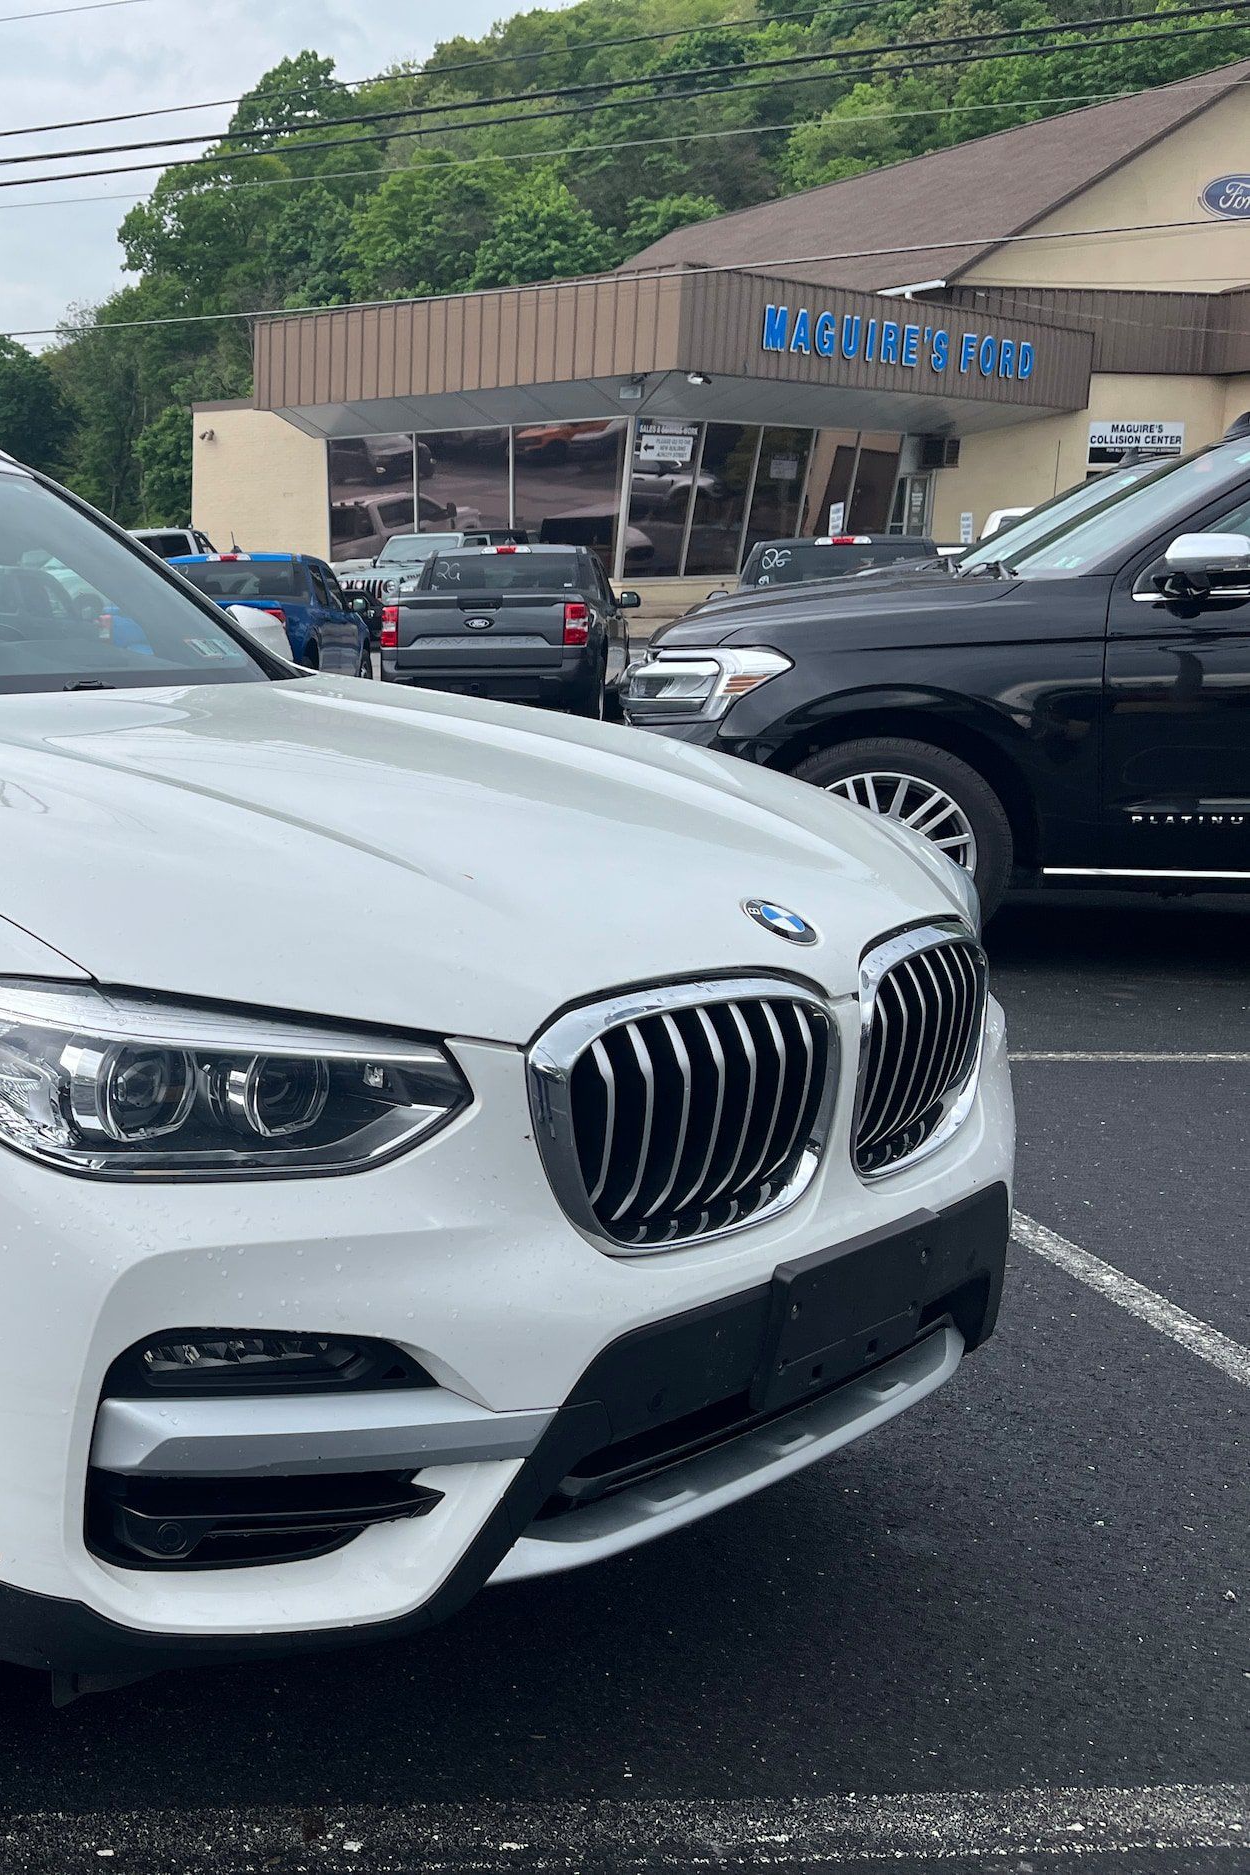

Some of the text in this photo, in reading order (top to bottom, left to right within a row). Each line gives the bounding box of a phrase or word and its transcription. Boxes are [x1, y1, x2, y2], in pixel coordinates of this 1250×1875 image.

[1219, 182, 1250, 209] For
[762, 304, 1035, 380] MAGUIRE'S FORD
[1111, 424, 1163, 433] MAGUIRE'S
[1090, 435, 1182, 444] COLLISION CENTER
[1131, 815, 1244, 825] PLATINU
